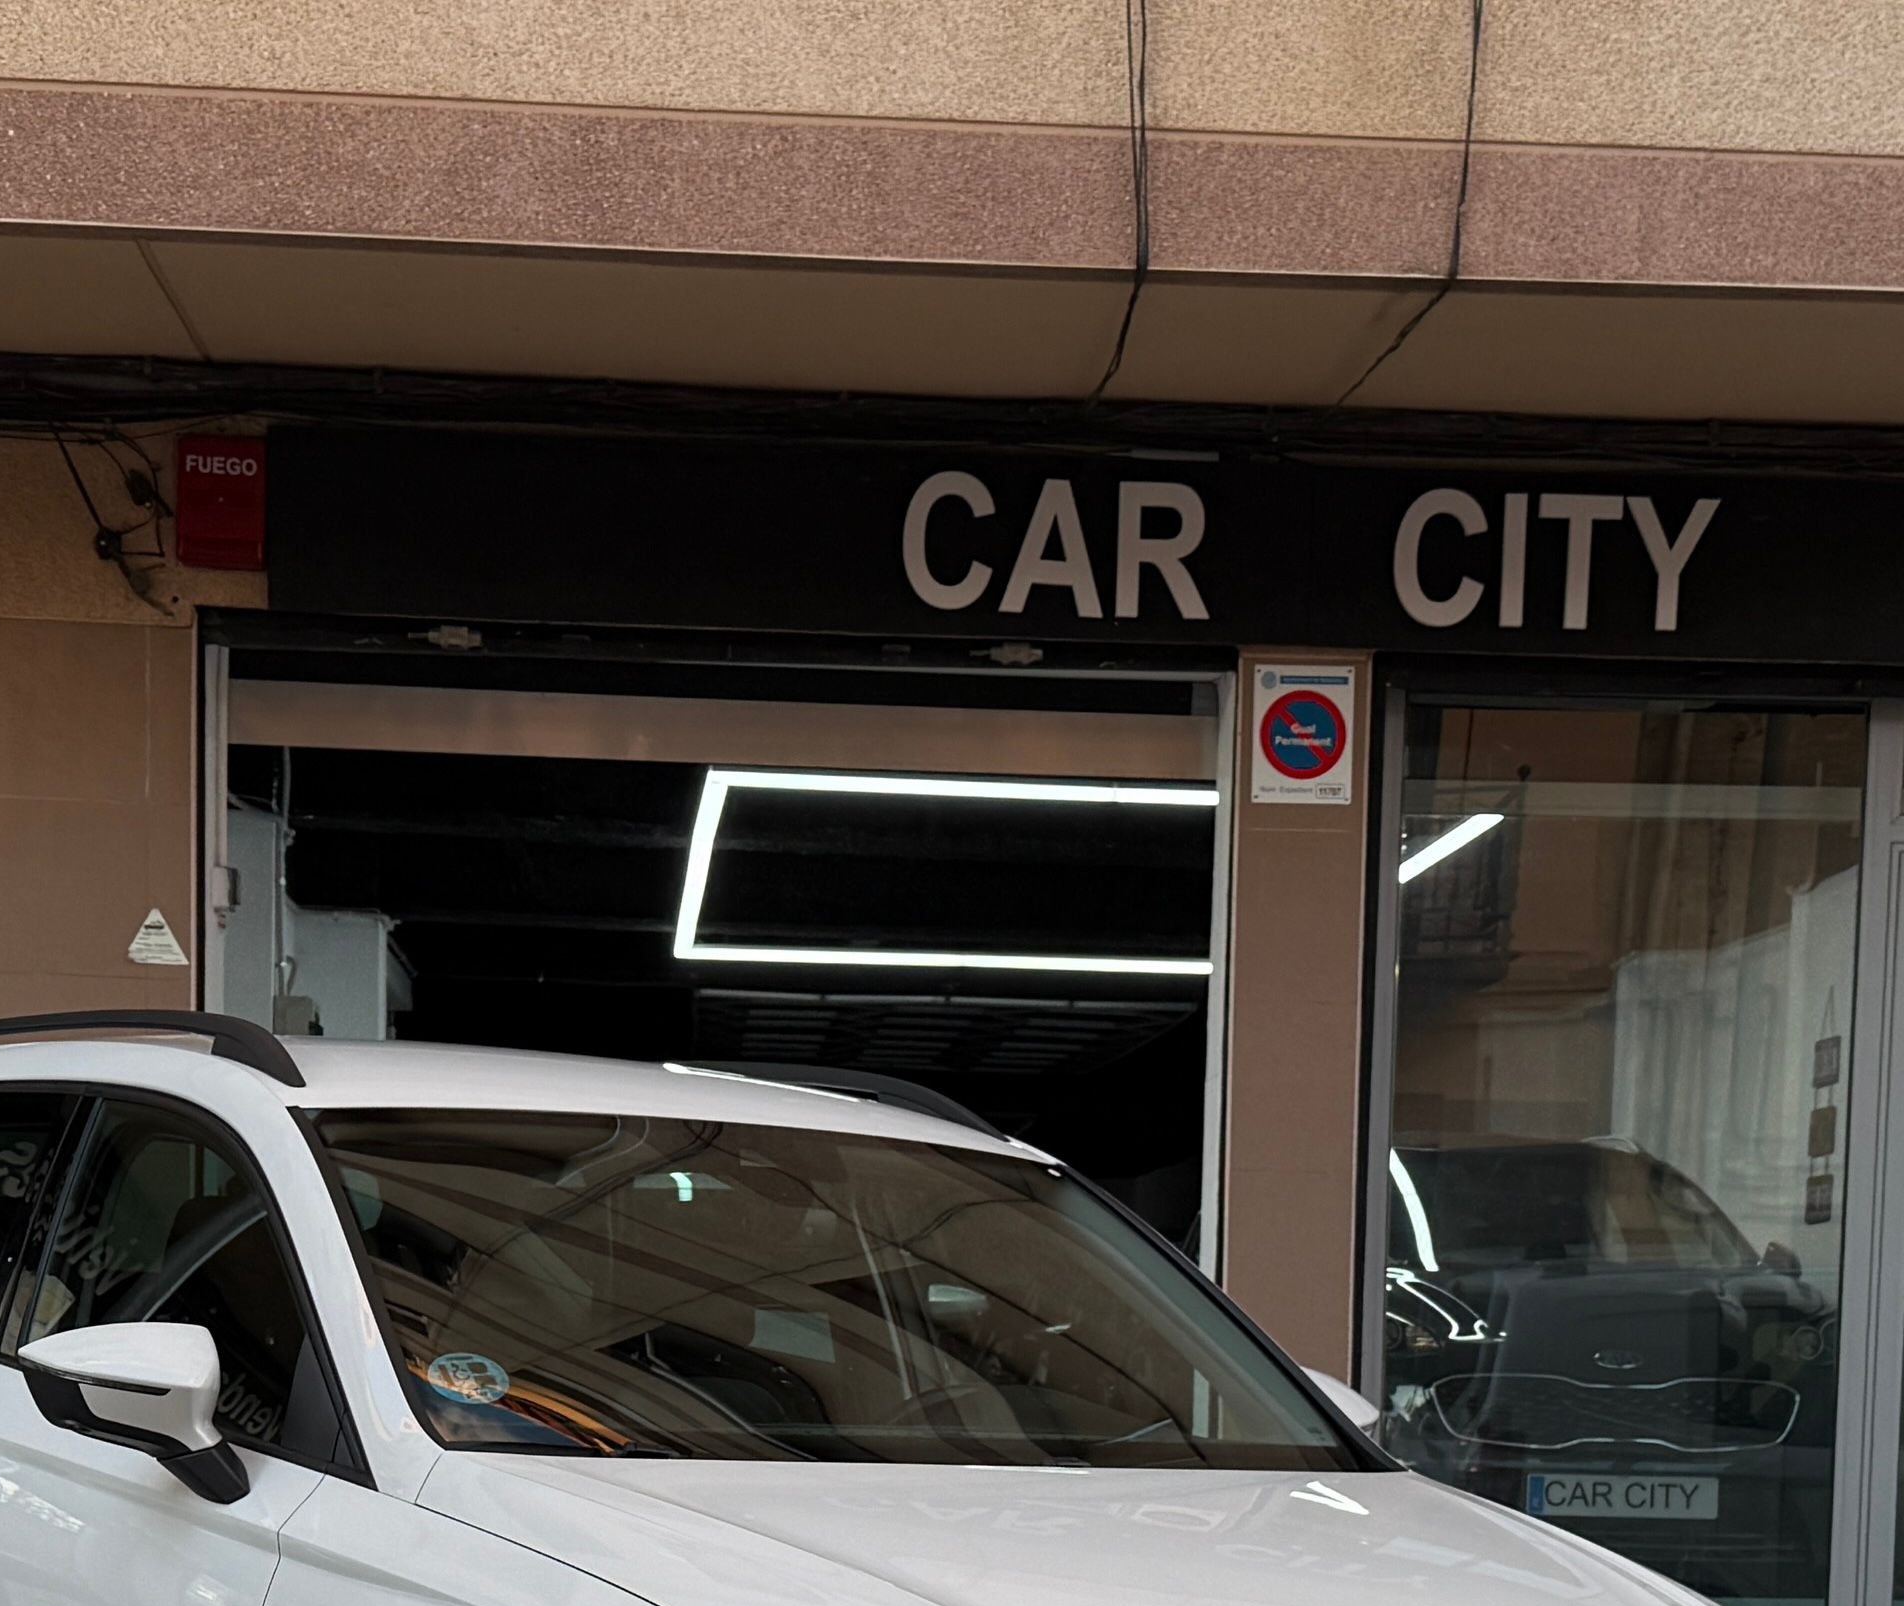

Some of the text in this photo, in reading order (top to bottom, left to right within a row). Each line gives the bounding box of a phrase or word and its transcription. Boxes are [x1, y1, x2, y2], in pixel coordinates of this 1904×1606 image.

[185, 455, 258, 477] FUEGO
[902, 470, 1722, 632] CAR CITY
[1544, 1480, 1700, 1510] CAR CITY
